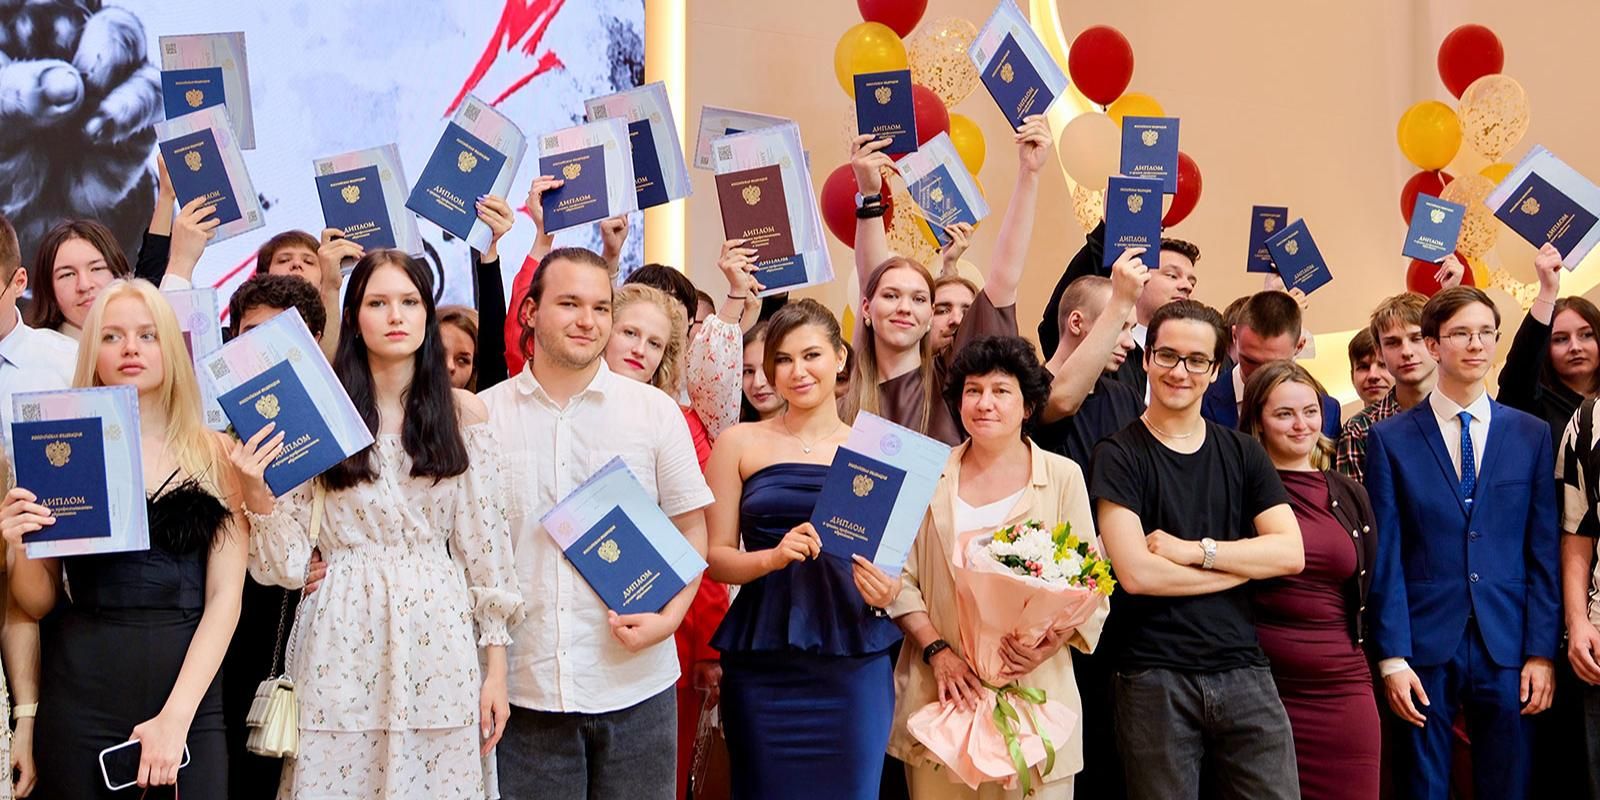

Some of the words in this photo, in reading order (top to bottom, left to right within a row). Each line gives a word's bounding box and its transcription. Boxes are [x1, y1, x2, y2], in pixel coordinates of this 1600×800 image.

[872, 124, 901, 133] ДИПЛОМ
[433, 185, 465, 207] ДИПЛОМ
[558, 194, 591, 207] ДИПЛОМ
[344, 221, 375, 234] ДИПЛОМ
[742, 226, 775, 238] ДИПЛОМ
[1119, 235, 1148, 243] ДИПЛОМ
[41, 496, 86, 506] ДИПЛОМ
[830, 516, 866, 534] ДИПЛОМ
[623, 570, 653, 599] ДИПЛОМ
